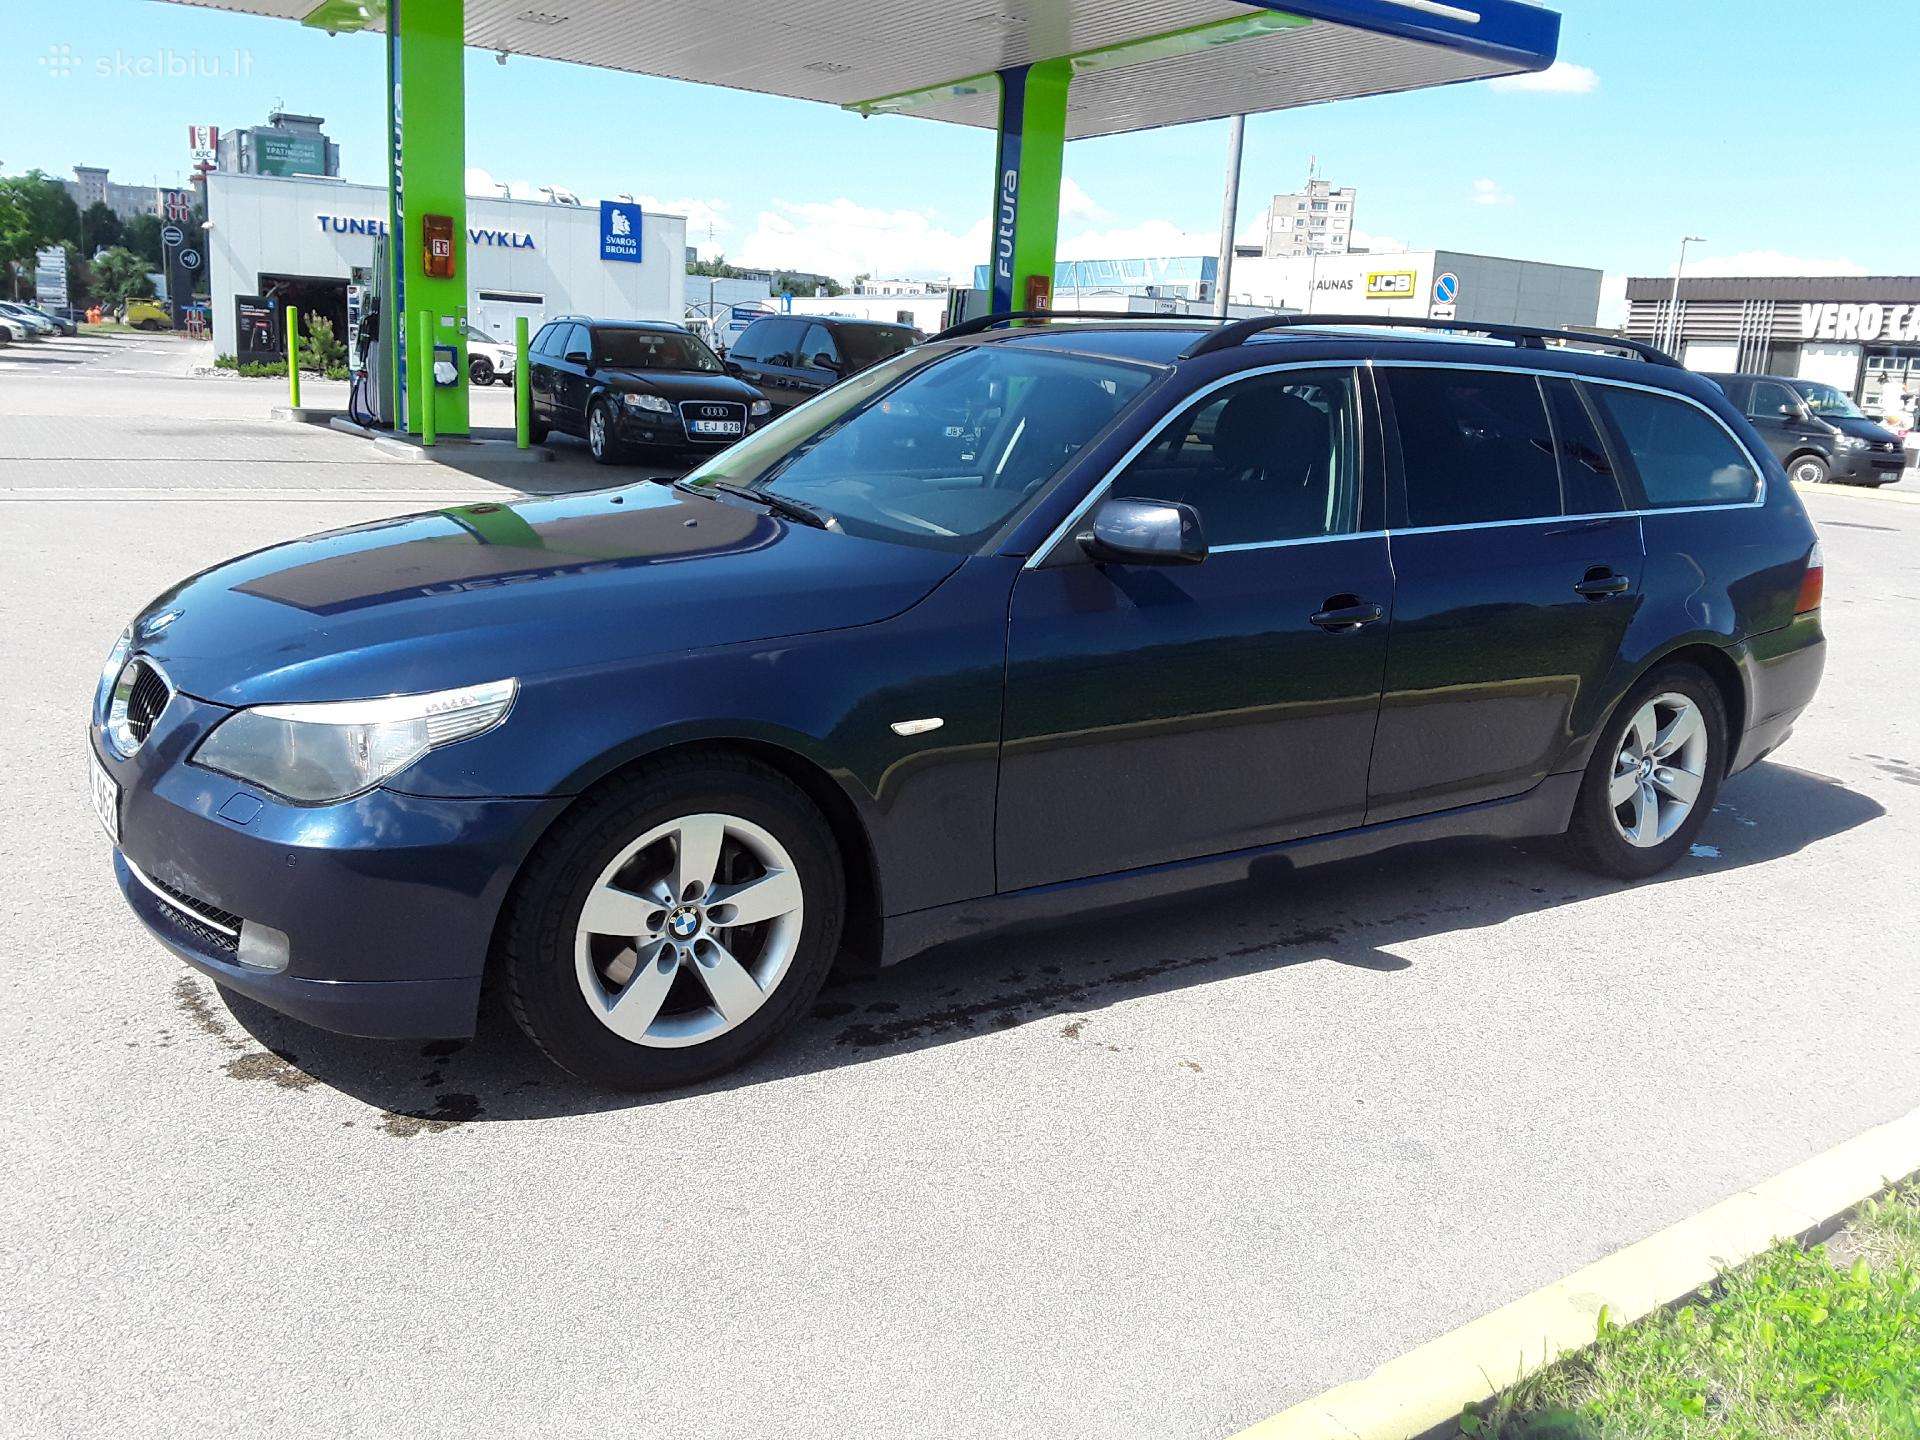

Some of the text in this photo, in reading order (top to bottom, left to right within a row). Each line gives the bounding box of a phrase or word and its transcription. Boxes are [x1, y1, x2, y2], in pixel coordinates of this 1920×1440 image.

[195, 150, 211, 158] KFC
[606, 234, 637, 247] ŠVAROS
[605, 245, 637, 255] BROLIAI
[1368, 274, 1411, 292] JCB
[1801, 303, 1884, 340] VERO
[697, 421, 718, 431] LEJ
